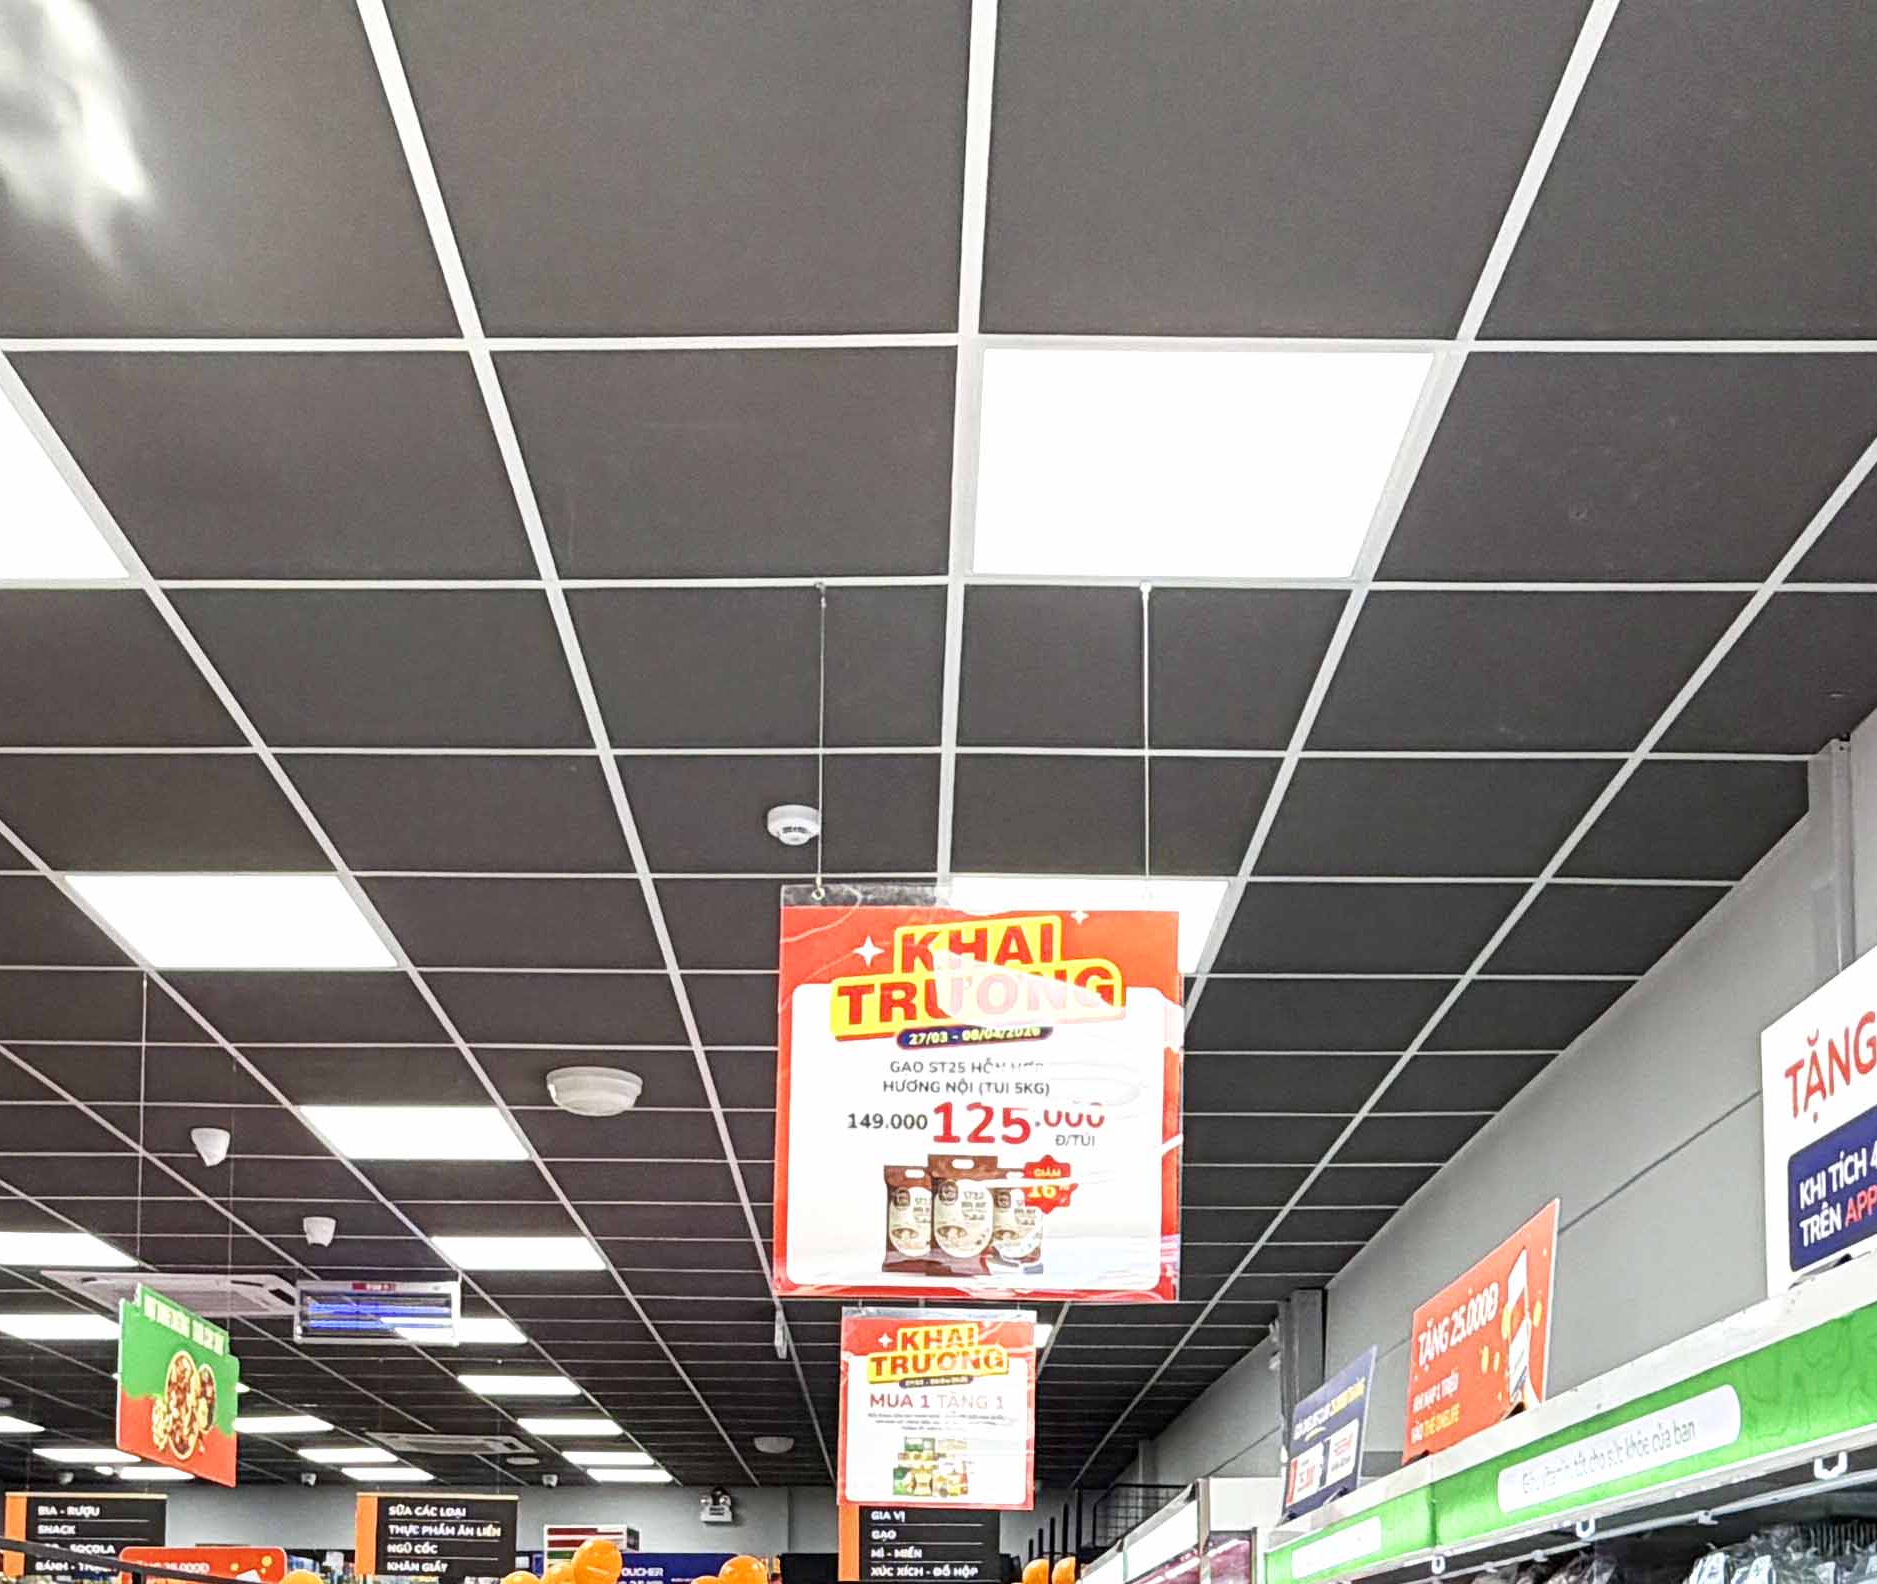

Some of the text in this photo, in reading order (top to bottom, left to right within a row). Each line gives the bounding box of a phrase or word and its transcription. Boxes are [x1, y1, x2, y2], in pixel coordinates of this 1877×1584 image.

[900, 922, 1056, 974] KHAI
[928, 1060, 967, 1074] ST25
[1013, 1081, 1051, 1097] 5KG)
[846, 1111, 929, 1131] 149.000
[1798, 1176, 1826, 1210] KHI
[1827, 1150, 1868, 1193] TÍCH
[1798, 1206, 1843, 1249] TRÊN
[901, 1326, 975, 1351] KHAI
[870, 1347, 1005, 1377] TRƯƠNG
[869, 1393, 914, 1409] MUA
[920, 1393, 931, 1409] 1
[995, 1395, 1004, 1410] 1
[870, 1510, 890, 1522] GIA
[617, 1566, 665, 1578] OUCHER
[870, 1563, 894, 1578] XÚC
